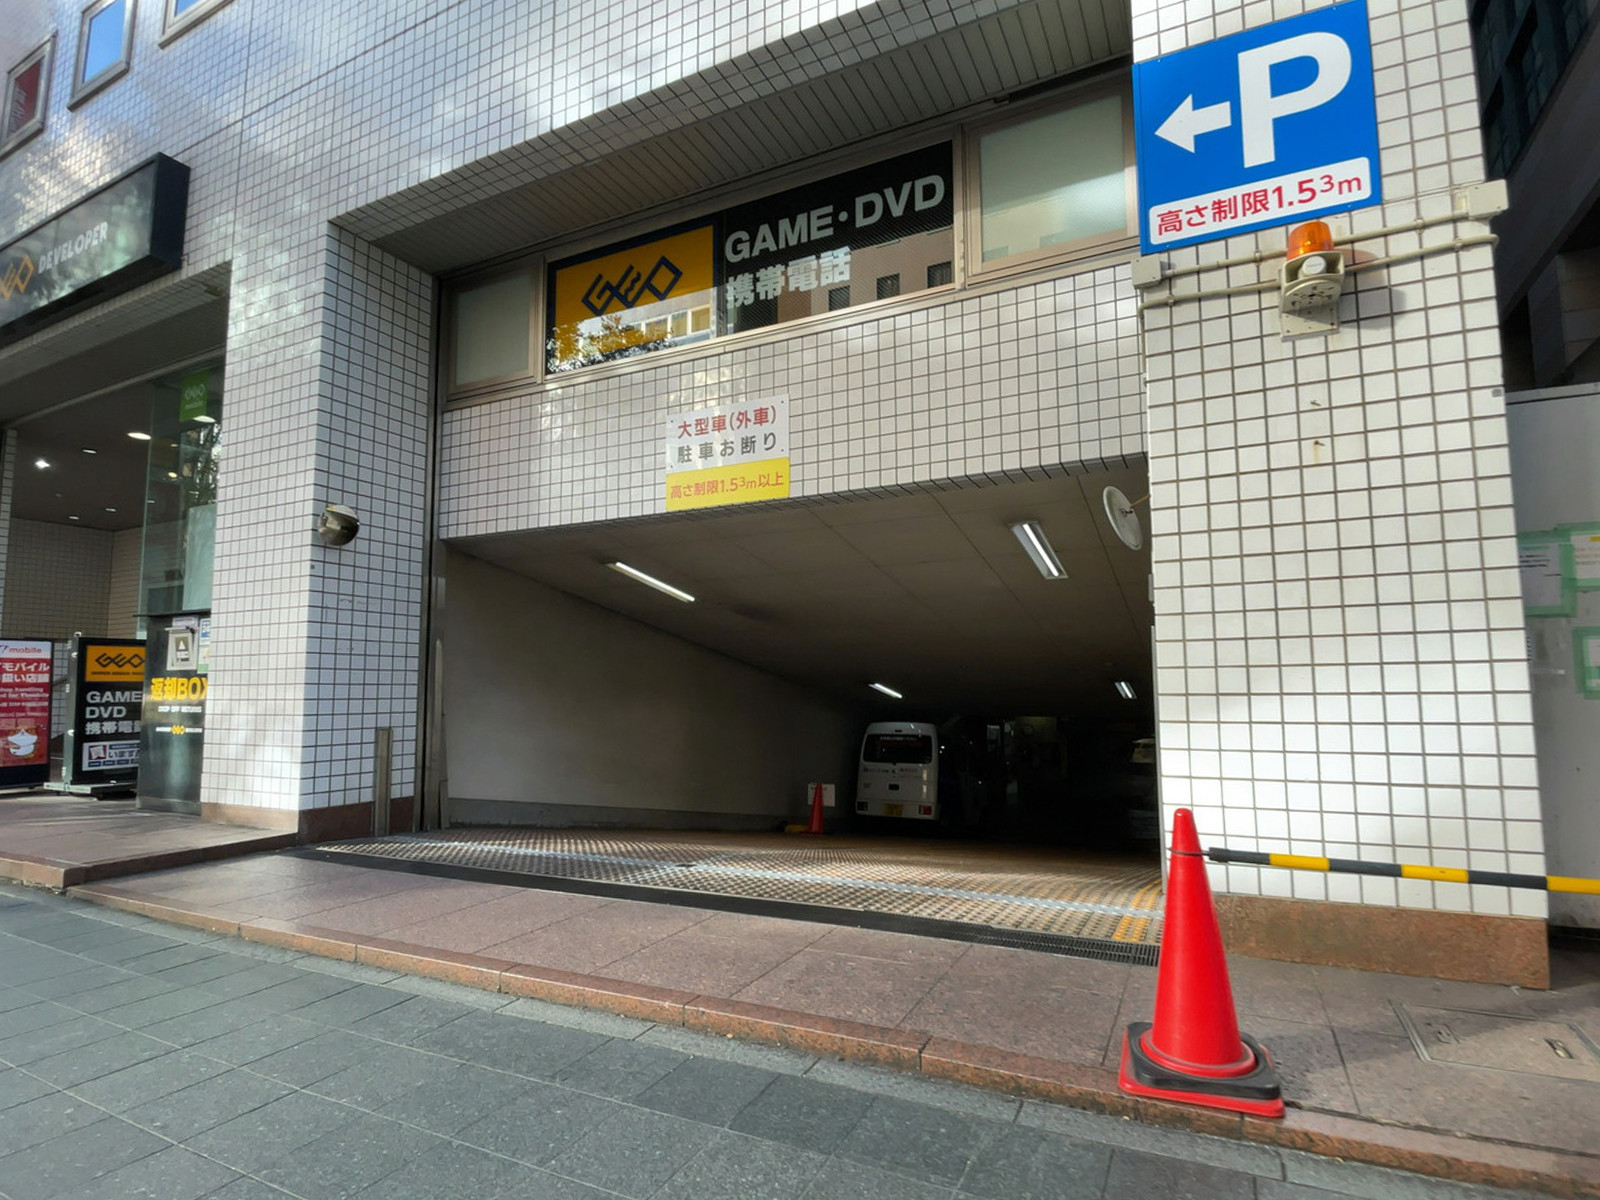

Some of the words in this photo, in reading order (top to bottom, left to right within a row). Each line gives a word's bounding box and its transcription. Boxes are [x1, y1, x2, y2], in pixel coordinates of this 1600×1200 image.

[1237, 31, 1353, 169] P
[38, 222, 108, 273] DEVELOPER
[724, 245, 852, 309] 携帯電話
[677, 404, 777, 440] 大型車(外車)
[677, 431, 777, 464] 駐車お断り
[85, 706, 127, 719] DVD
[86, 690, 143, 704] GAME
